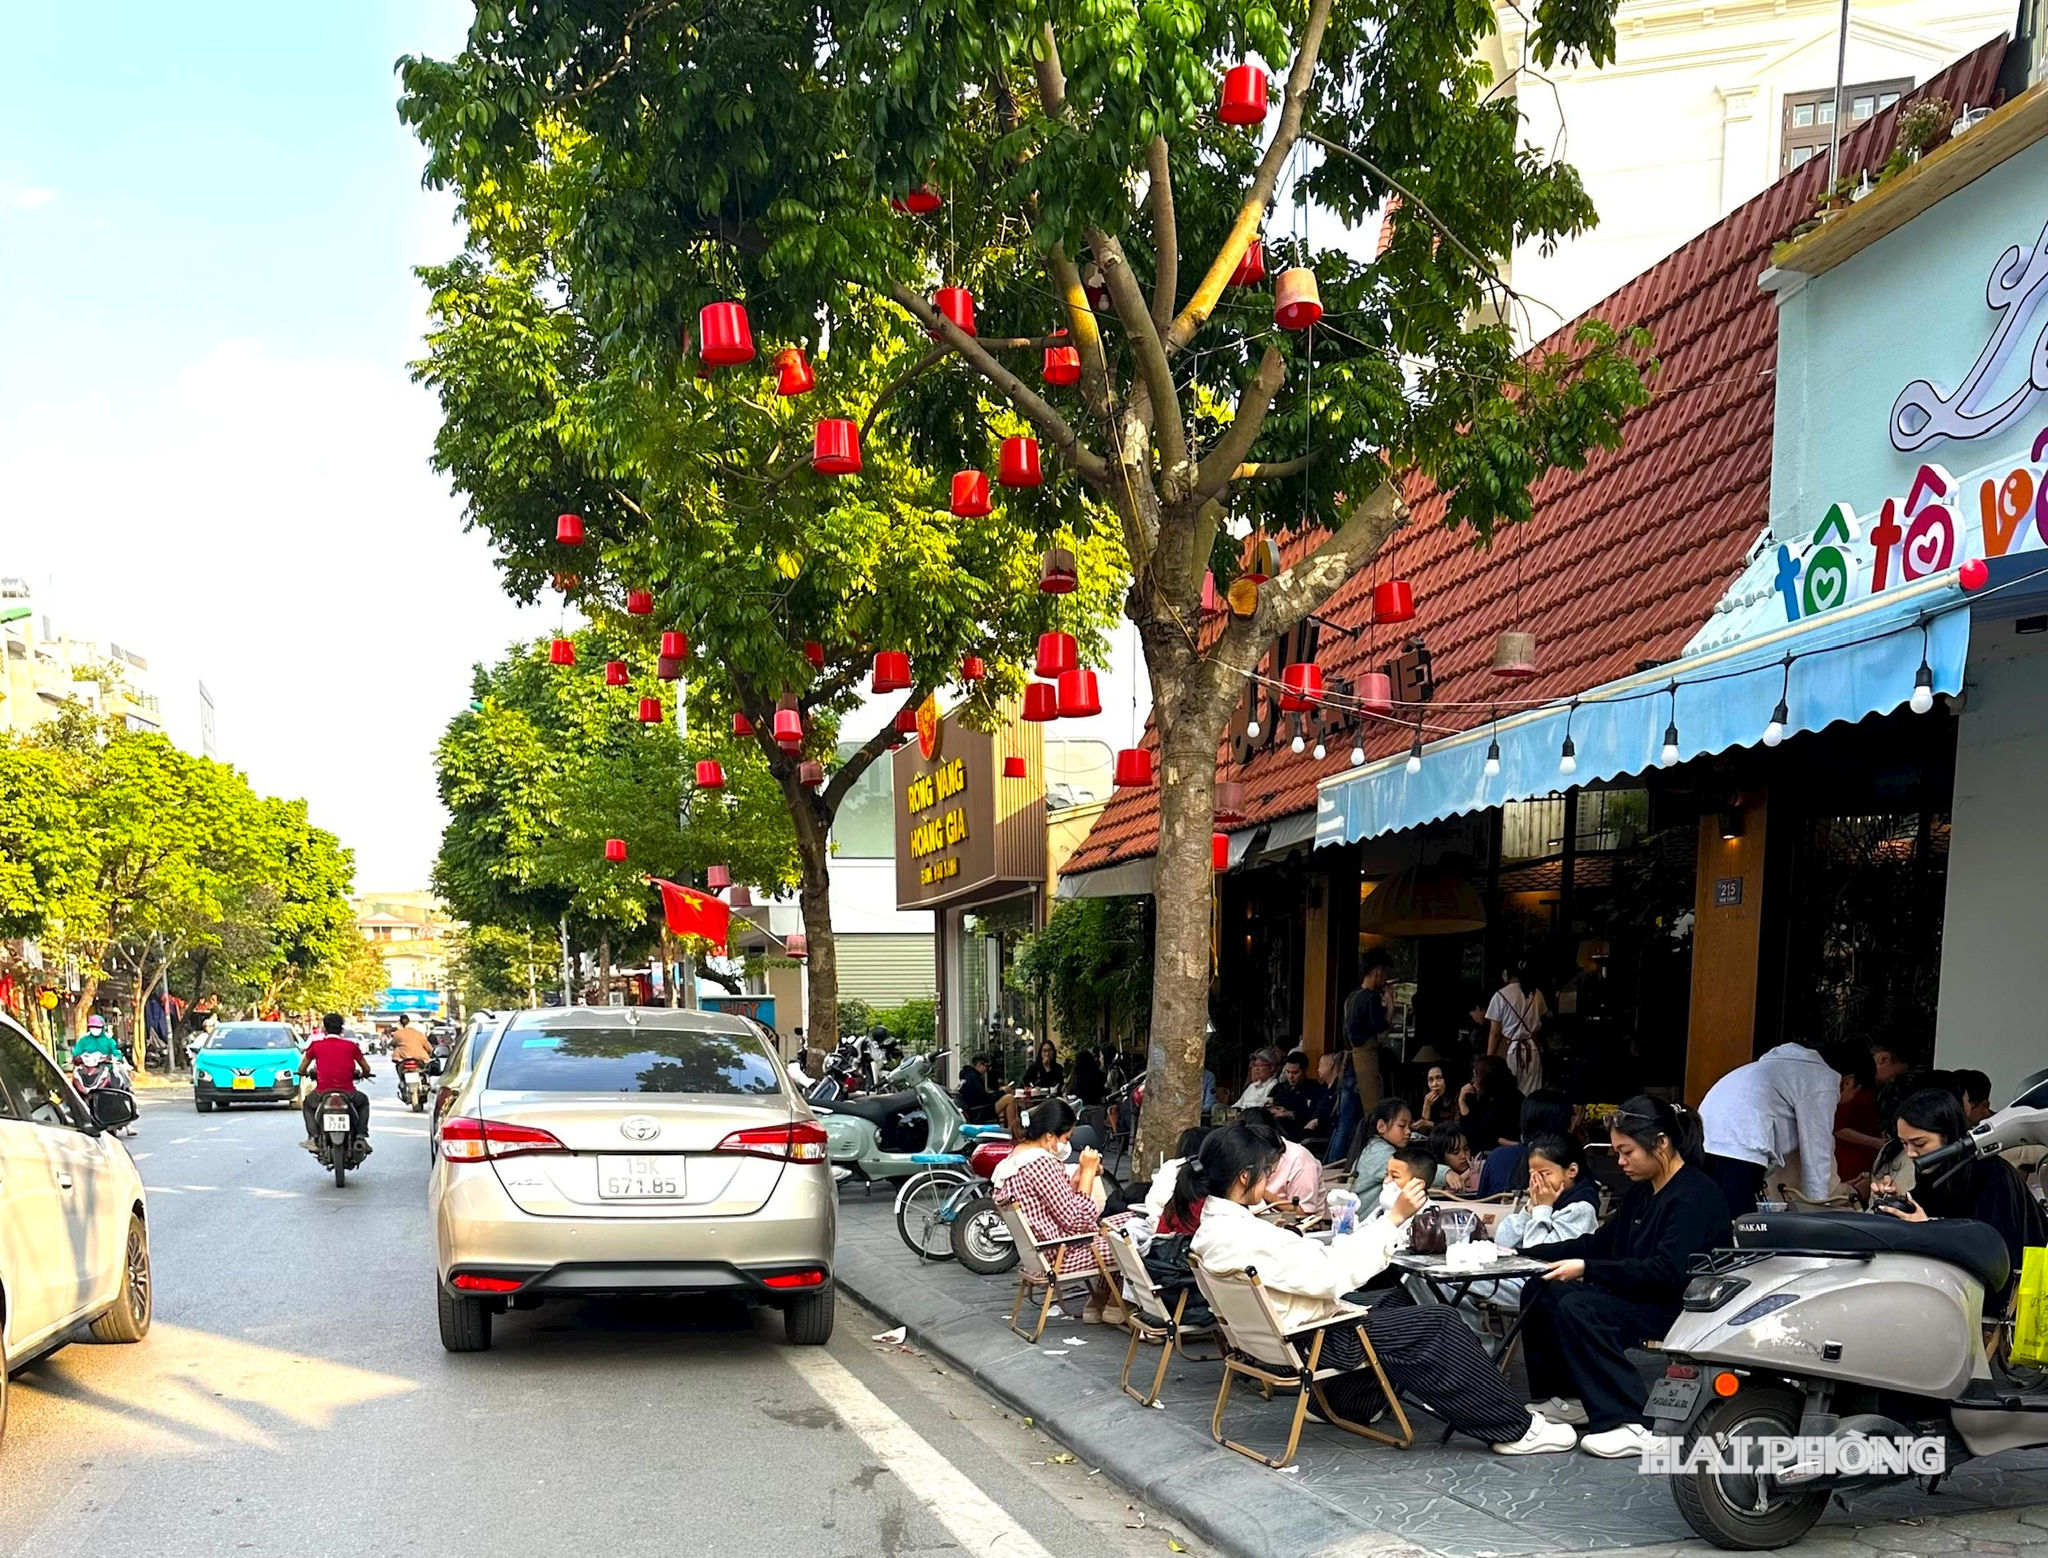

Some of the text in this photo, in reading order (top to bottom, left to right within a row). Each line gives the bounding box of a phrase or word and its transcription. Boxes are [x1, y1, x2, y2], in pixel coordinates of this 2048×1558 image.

[1890, 219, 2048, 452] L
[1775, 427, 2048, 622] tô tô v
[907, 755, 964, 814] RỒNG VÀNG
[910, 808, 966, 858] HOÀNG GIA
[1720, 883, 1736, 897] 215
[608, 1177, 677, 1194] 671.85
[626, 1157, 659, 1174] 15K
